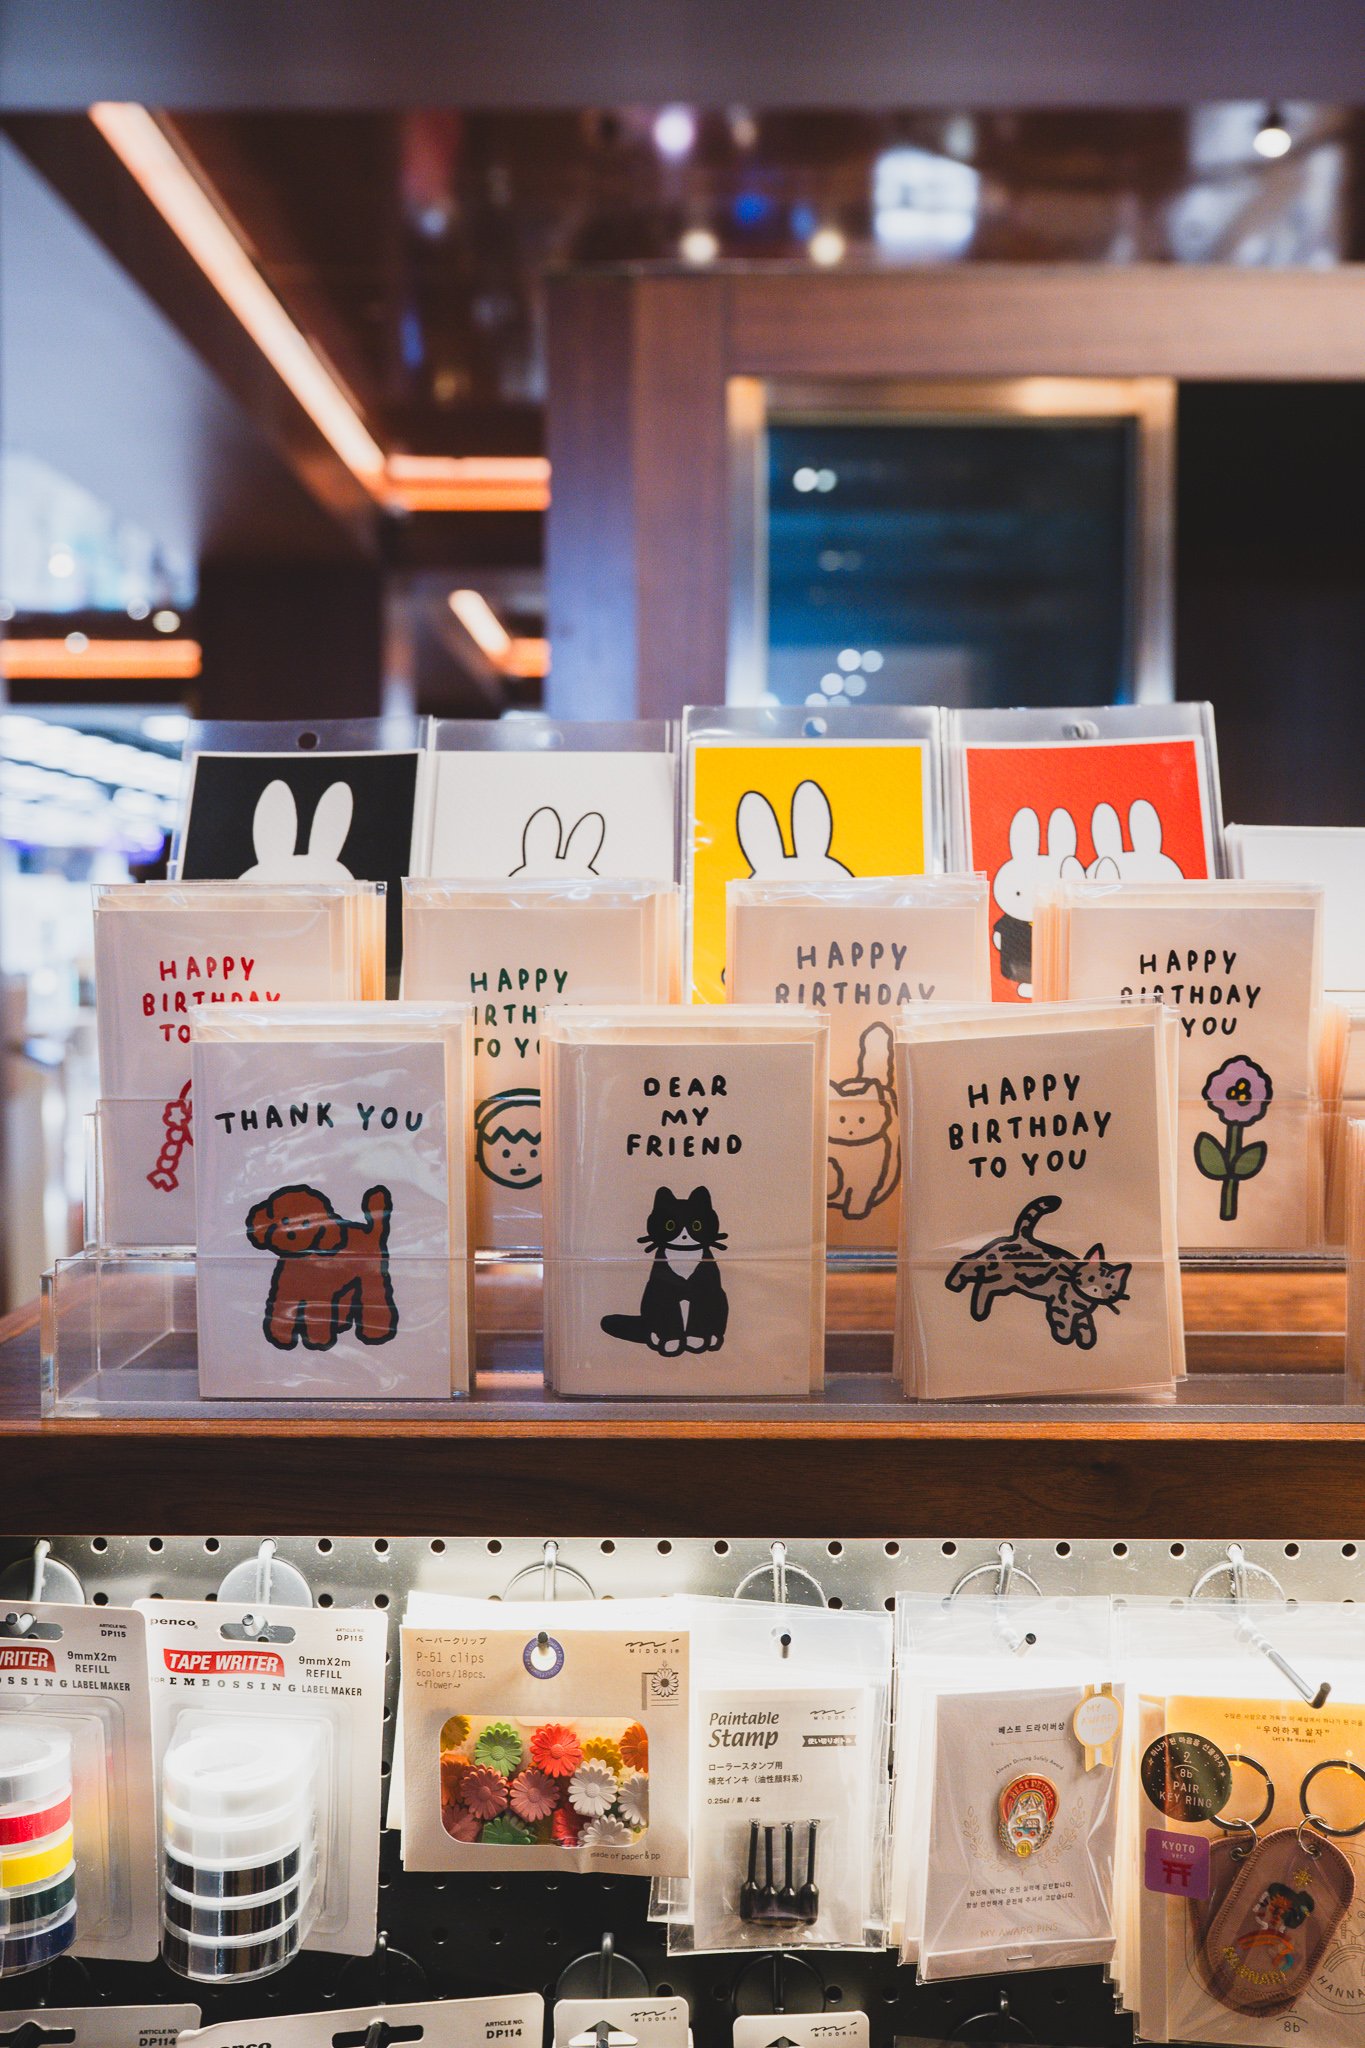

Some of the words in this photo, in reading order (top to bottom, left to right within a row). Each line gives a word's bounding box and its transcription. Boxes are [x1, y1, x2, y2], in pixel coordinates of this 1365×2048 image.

[797, 941, 907, 971] HAPPY
[1139, 950, 1237, 974] HAPPY
[160, 956, 255, 981] HAPPY
[470, 968, 568, 993] HAPPY
[775, 981, 935, 1007] BIRTHDAY
[159, 1024, 191, 1043] TO
[1181, 1016, 1237, 1038] YOU
[474, 1037, 501, 1058] TO
[643, 1074, 728, 1098] DEAR
[968, 1073, 1080, 1108] HAPPY
[215, 1102, 334, 1134] THANK
[357, 1102, 423, 1132] YOU
[661, 1106, 709, 1127] MY
[948, 1110, 1112, 1150] BIRTHDAY
[627, 1134, 742, 1157] FRIEND
[968, 1156, 1007, 1178] TO
[1021, 1149, 1087, 1176] YOU
[101, 1630, 126, 1638] DP115
[416, 1637, 487, 1645] ペーパークリップ
[0, 1651, 49, 1668] RITER
[67, 1651, 117, 1662] 9mmX2m
[169, 1653, 212, 1670] TAPE
[215, 1654, 278, 1672] WRITER
[299, 1656, 351, 1667] 9mmX2m
[416, 1651, 442, 1663] P-51
[450, 1652, 484, 1665] clips
[75, 1664, 110, 1674] REFILL
[306, 1669, 342, 1679] REFILL
[416, 1668, 486, 1679] 6colors/18pcs.
[73, 1680, 99, 1690] LABEL
[100, 1682, 130, 1691] MAKER
[170, 1677, 296, 1692] EMBOSSING
[302, 1685, 329, 1694] LABEL
[331, 1686, 362, 1696] MAKER
[709, 1712, 780, 1726] Paintable
[998, 1726, 1022, 1734] 베스트
[1026, 1722, 1065, 1732] 드라이버상
[708, 1729, 779, 1749] Stamp
[708, 1761, 783, 1771] ローラースタンプ用
[1180, 1768, 1193, 1779] 8b
[1173, 1781, 1199, 1794] PAIR
[1160, 1791, 1180, 1803] KEY
[1185, 1795, 1212, 1808] RING
[1161, 1840, 1195, 1854] KYOTO
[621, 1853, 642, 1861] paper
[644, 1851, 649, 1859] &
[651, 1852, 661, 1861] pp
[485, 2019, 512, 2027] ARTICLE
[1283, 2021, 1301, 2033] 8b
[486, 2028, 522, 2039] DP114
[139, 2037, 177, 2047] DP114
